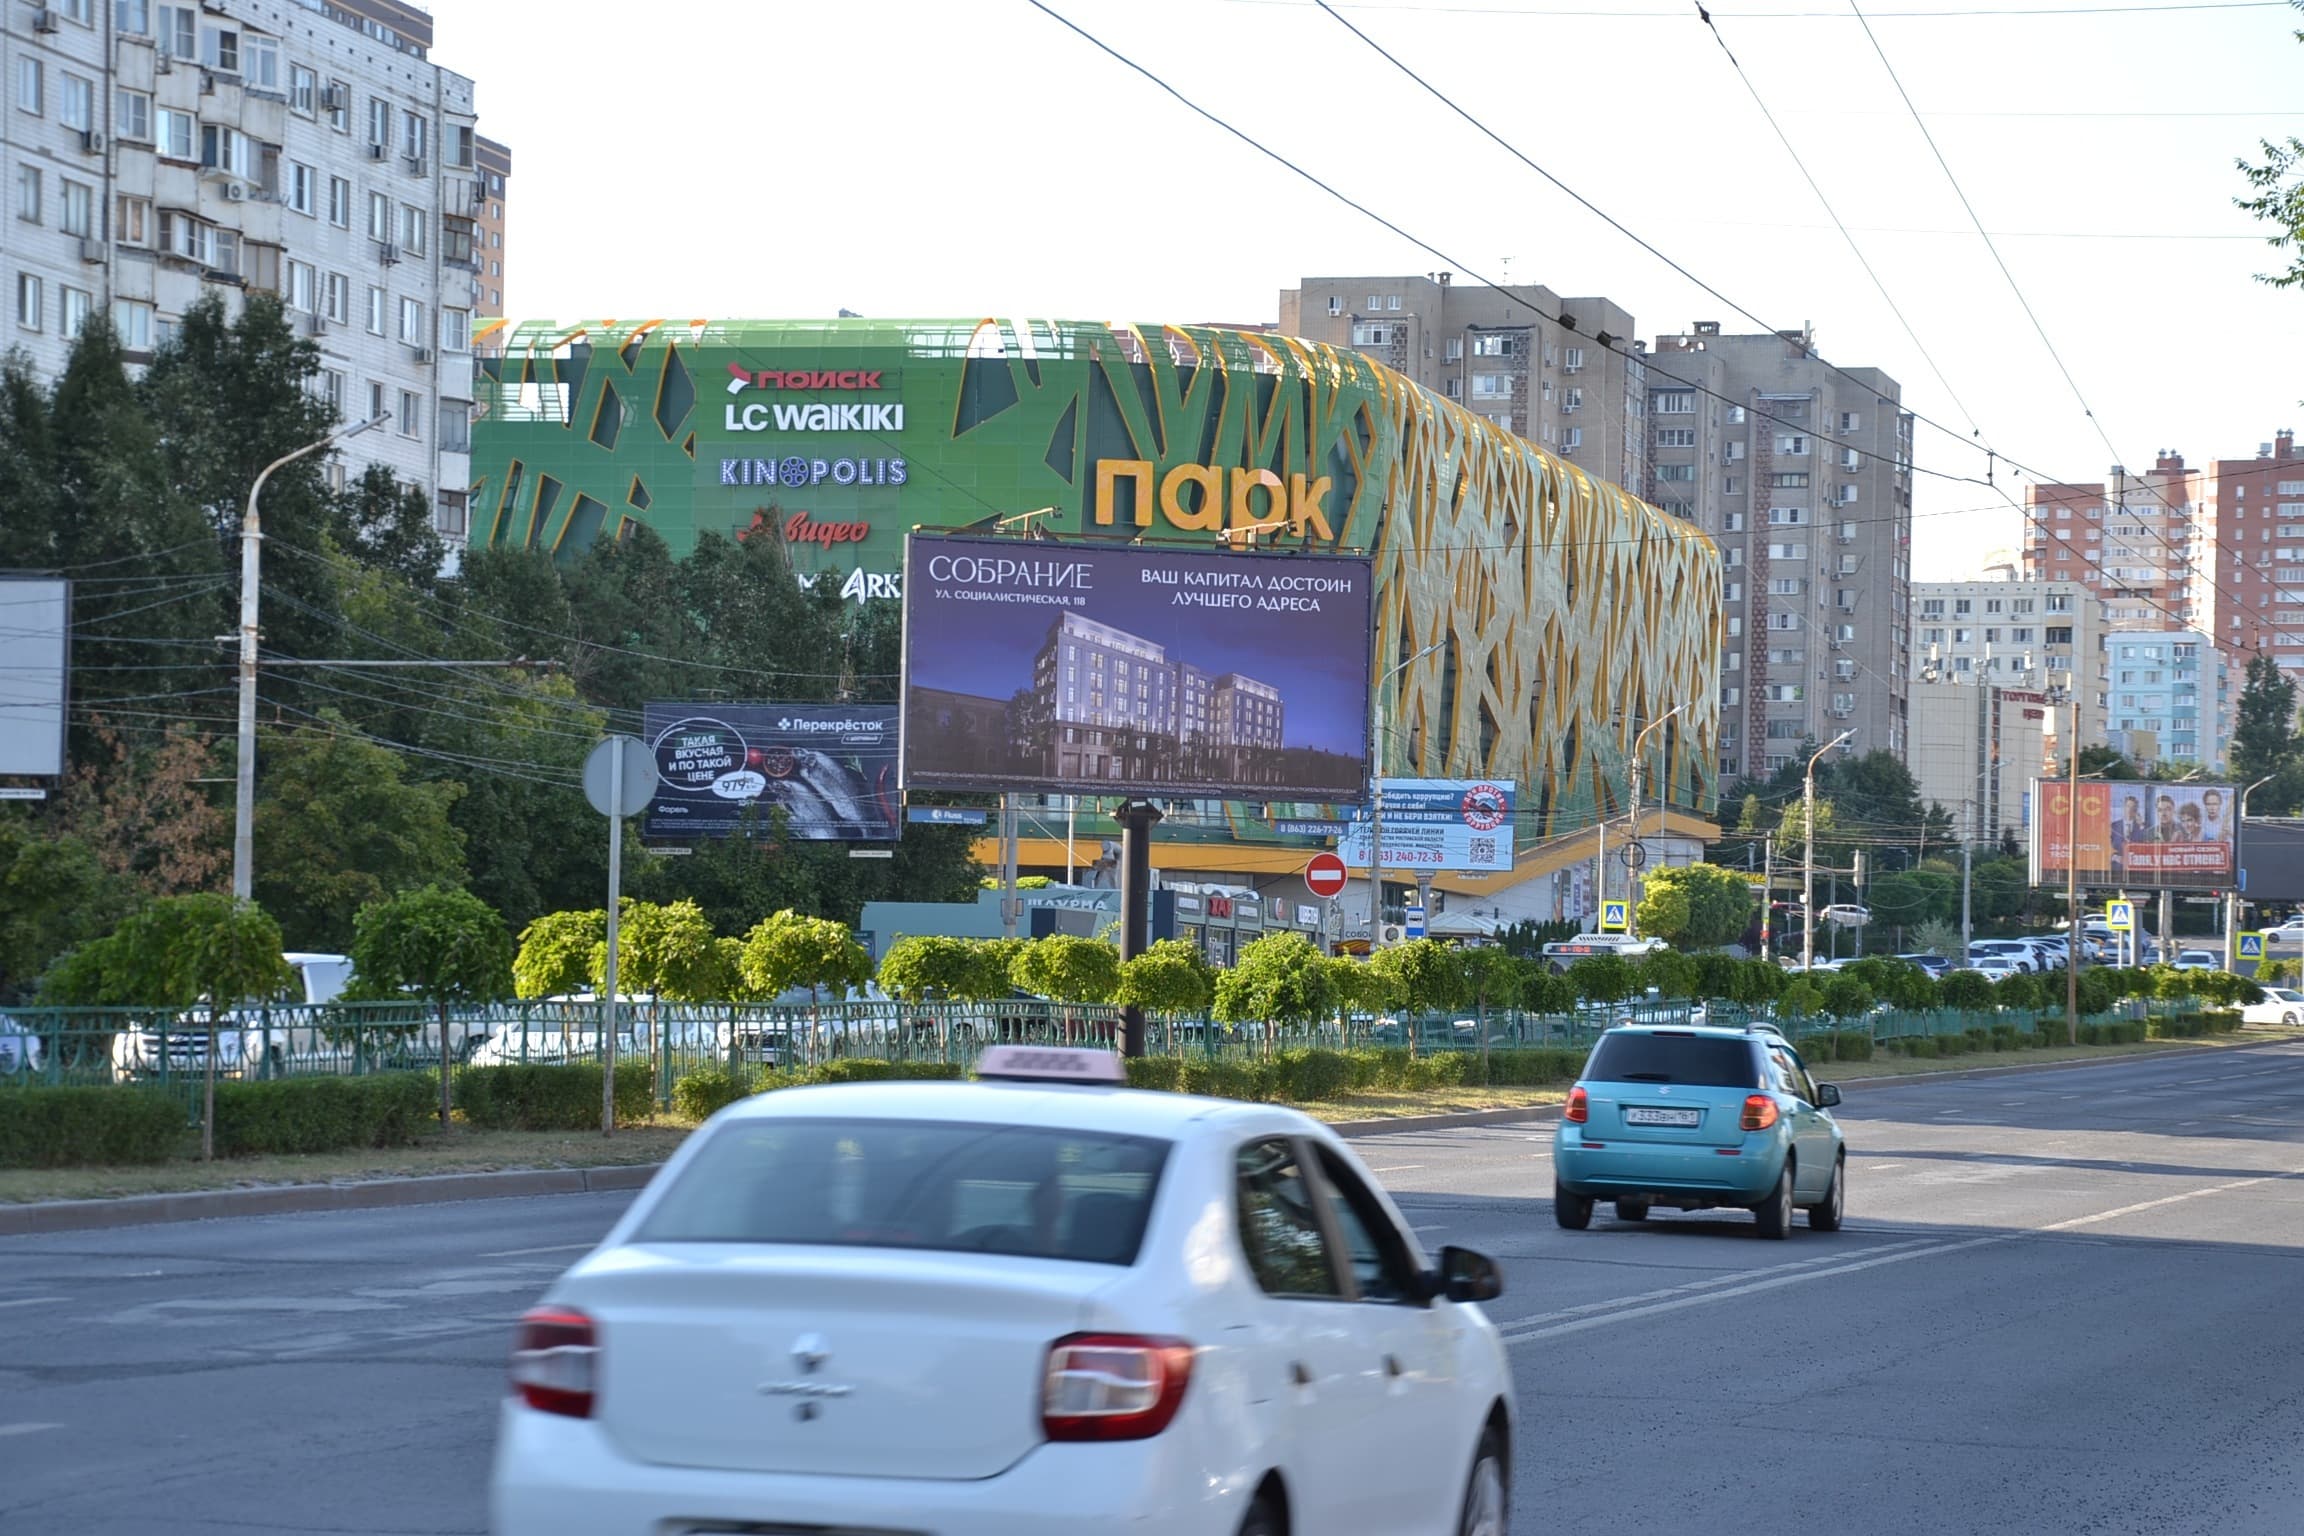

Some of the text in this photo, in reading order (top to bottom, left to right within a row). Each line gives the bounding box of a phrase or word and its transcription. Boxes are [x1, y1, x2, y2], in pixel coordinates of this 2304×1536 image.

[758, 371, 882, 389] ПОИСК
[725, 404, 768, 430] LC
[720, 456, 907, 488] KINOPOLIS
[1095, 459, 1334, 550] парк
[929, 555, 1093, 589] СОБРАНИЕ
[1141, 569, 1352, 593] ВАШ КАПИТАЛ ДОСТОИН
[935, 588, 1086, 606] УЛ. СОЦИАЛИСТИЧЕСКАЯ, 118
[1172, 591, 1321, 612] ЛУЧШЕГО АДРЕСА
[793, 718, 883, 733] Перекрёсток
[681, 735, 716, 748] ТАКАЯ
[675, 746, 724, 760] ВКУСНАЯ
[668, 755, 732, 771] И ПО ТАКОЙ
[687, 770, 715, 783] ЦЕНЕ
[2049, 796, 2102, 816] СС
[1404, 812, 1422, 820] БЕРИ
[1027, 898, 1107, 910] ШАУРМА
